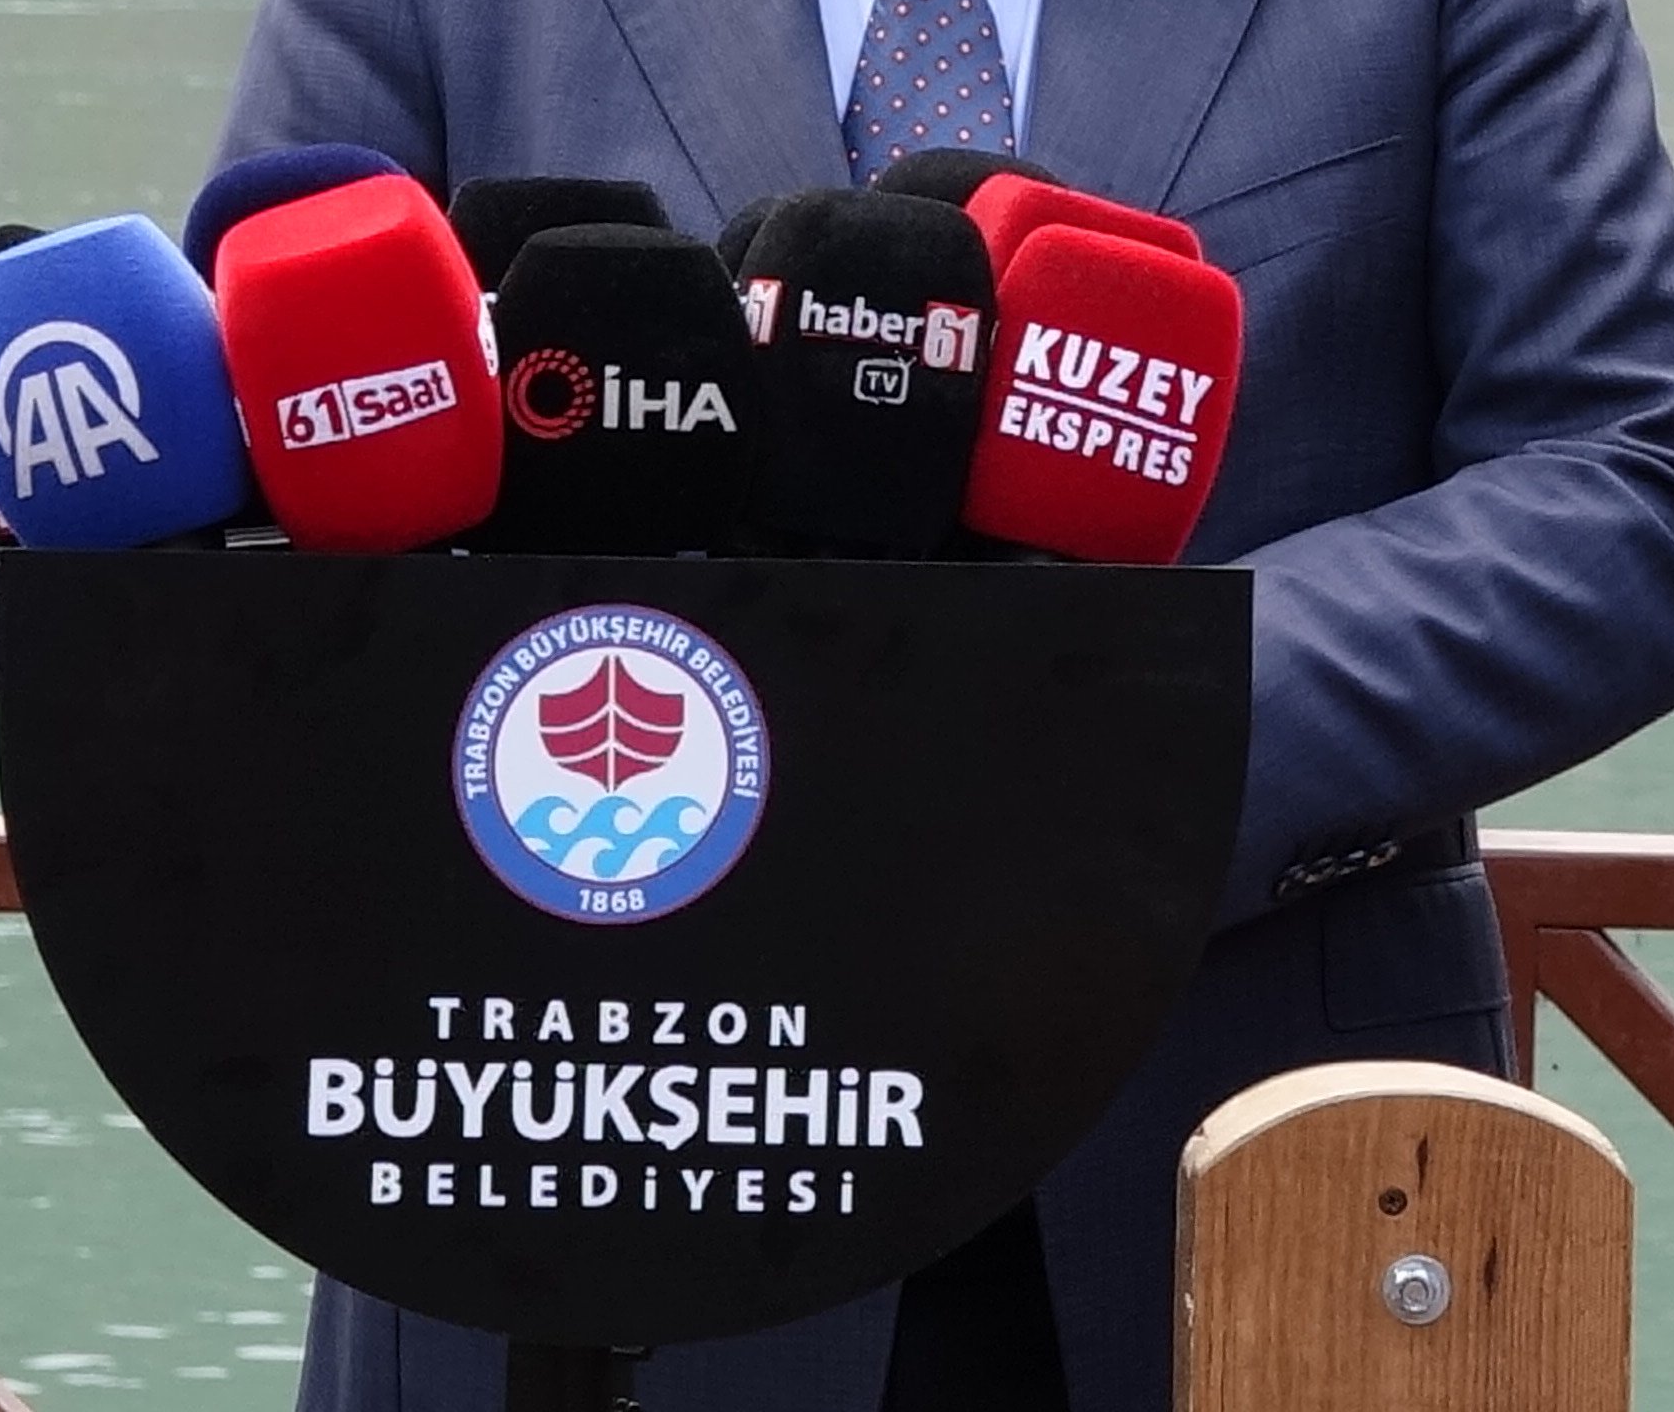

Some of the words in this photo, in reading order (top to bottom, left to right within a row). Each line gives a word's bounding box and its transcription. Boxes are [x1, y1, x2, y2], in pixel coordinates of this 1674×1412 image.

[602, 364, 738, 432] İHA
[866, 370, 899, 392] TV
[1014, 322, 1214, 425] KUZEY
[15, 360, 160, 498] AA
[999, 395, 1192, 485] EKSPRES
[464, 666, 521, 800] TRABZON
[513, 615, 690, 671] BÜYÜKŞEHİR
[688, 646, 760, 800] BELEDİYESİ
[579, 888, 646, 913] 1868
[429, 997, 807, 1047] TRABZON
[307, 1058, 923, 1150] BÜYÜKŞEHİR
[371, 1163, 854, 1214] BELEDİYESİ
